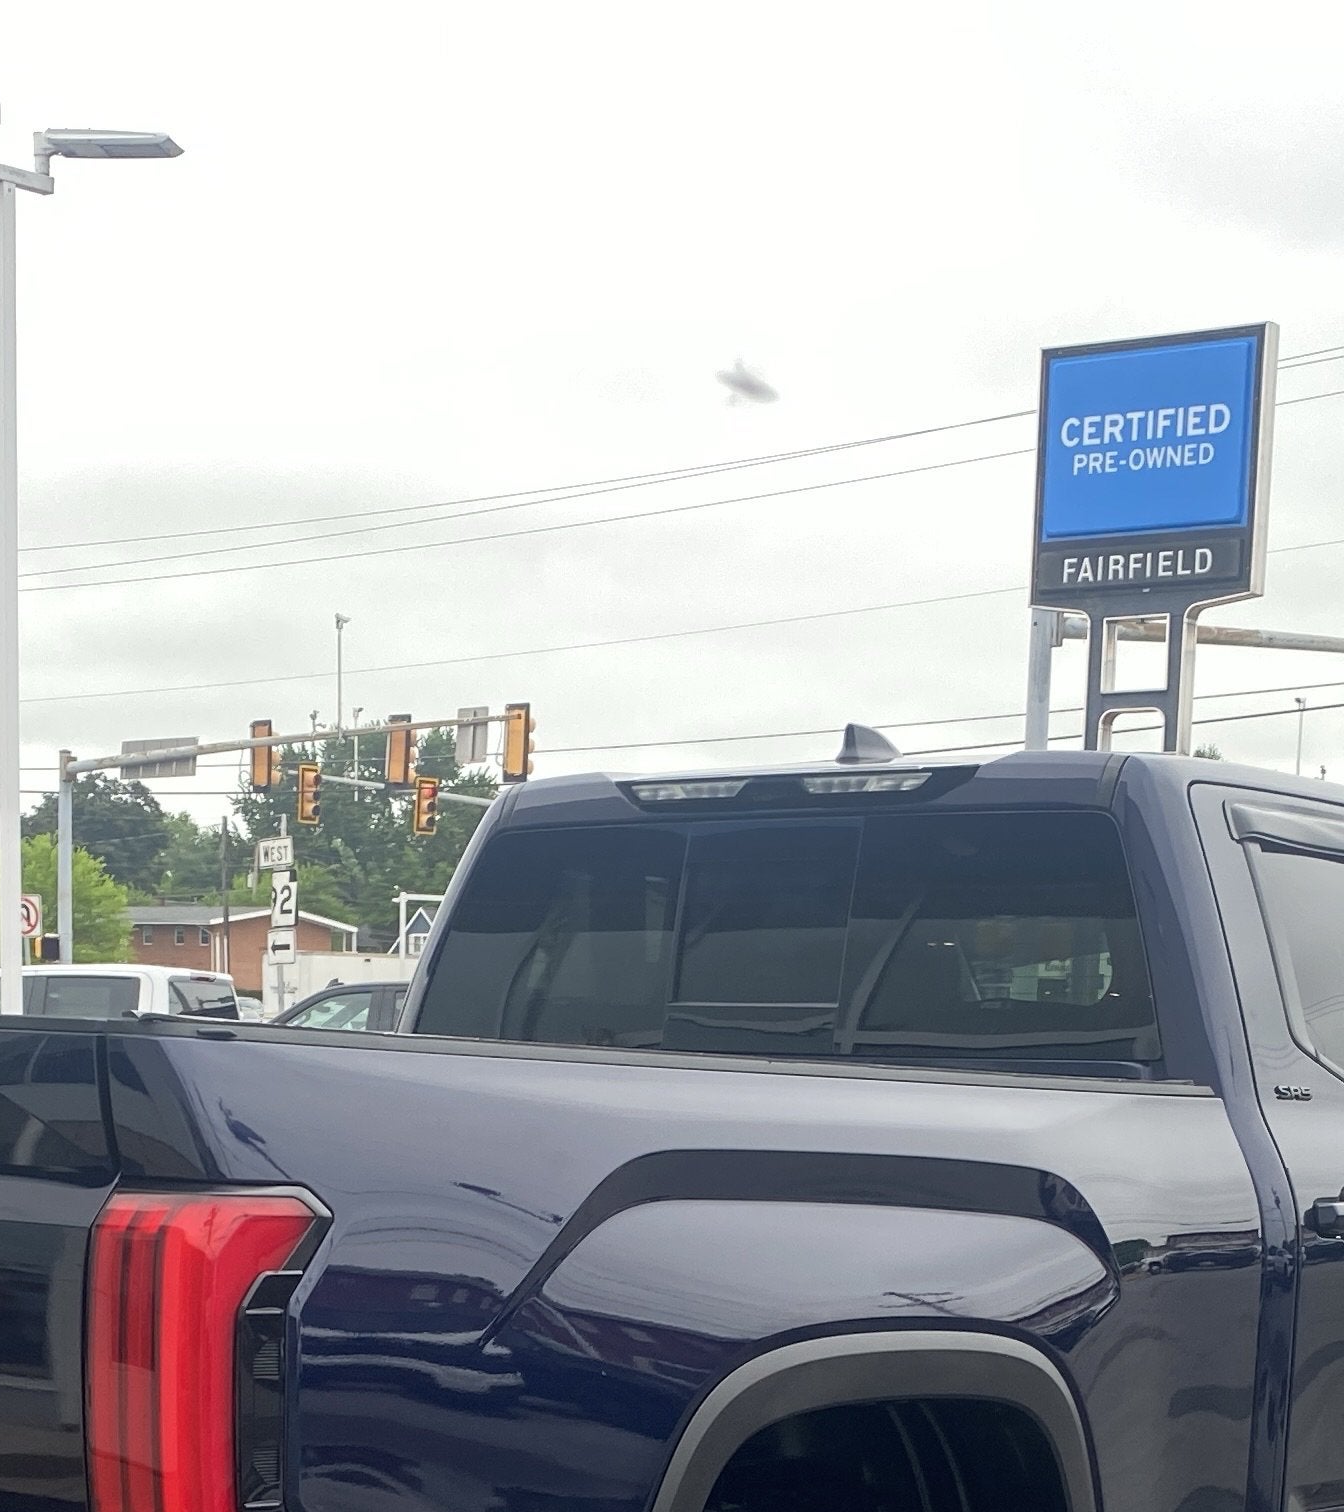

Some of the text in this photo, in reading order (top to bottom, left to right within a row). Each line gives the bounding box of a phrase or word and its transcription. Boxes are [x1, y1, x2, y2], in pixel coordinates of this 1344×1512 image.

[1060, 403, 1232, 448] CERTIFIED
[1072, 442, 1215, 476] PRE-OWNED
[1062, 547, 1213, 584] FAIRFIELD
[262, 845, 289, 863] WEST
